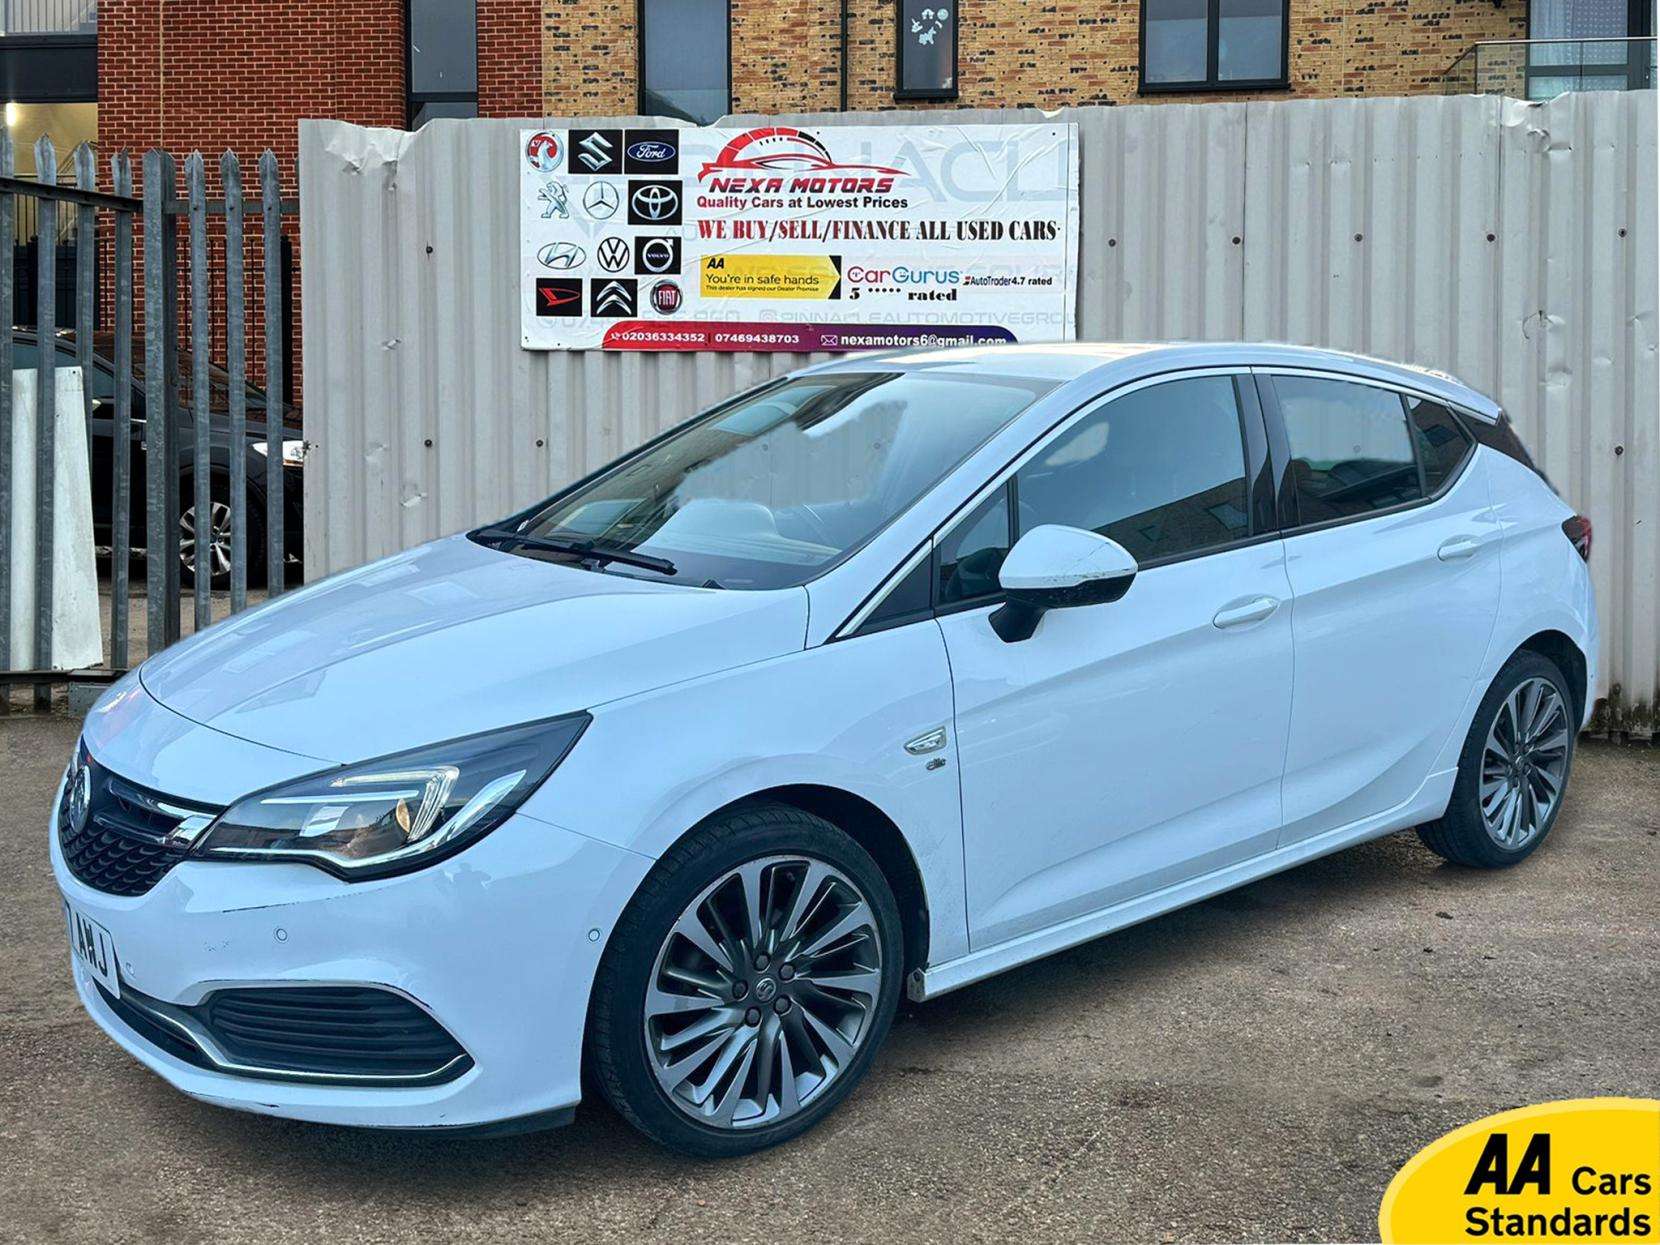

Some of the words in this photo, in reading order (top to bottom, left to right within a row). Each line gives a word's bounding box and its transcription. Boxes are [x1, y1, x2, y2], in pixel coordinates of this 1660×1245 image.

[636, 144, 667, 158] Ford
[709, 177, 784, 193] NEXA
[789, 177, 895, 193] MOTORS
[697, 196, 748, 210] Quality
[752, 197, 784, 208] Cars
[788, 198, 803, 208] at
[807, 197, 859, 208] Lowest
[863, 196, 908, 208] Prices
[697, 219, 727, 240] WE
[733, 219, 911, 242] BUY/SELL/FINANCE
[916, 220, 951, 240] ALL
[956, 220, 1004, 241] USED
[1008, 220, 1057, 241] CARS
[707, 257, 725, 270] AA
[706, 273, 741, 285] You're
[744, 274, 754, 284] in
[757, 274, 781, 285] safe
[784, 275, 820, 285] hands
[847, 265, 960, 284] CarGurus
[1028, 277, 1053, 286] rated
[658, 290, 677, 306] FIAT
[849, 287, 861, 300] 5
[908, 288, 958, 301] rated
[622, 333, 705, 343] 02036334352
[714, 333, 800, 344] 07469438703
